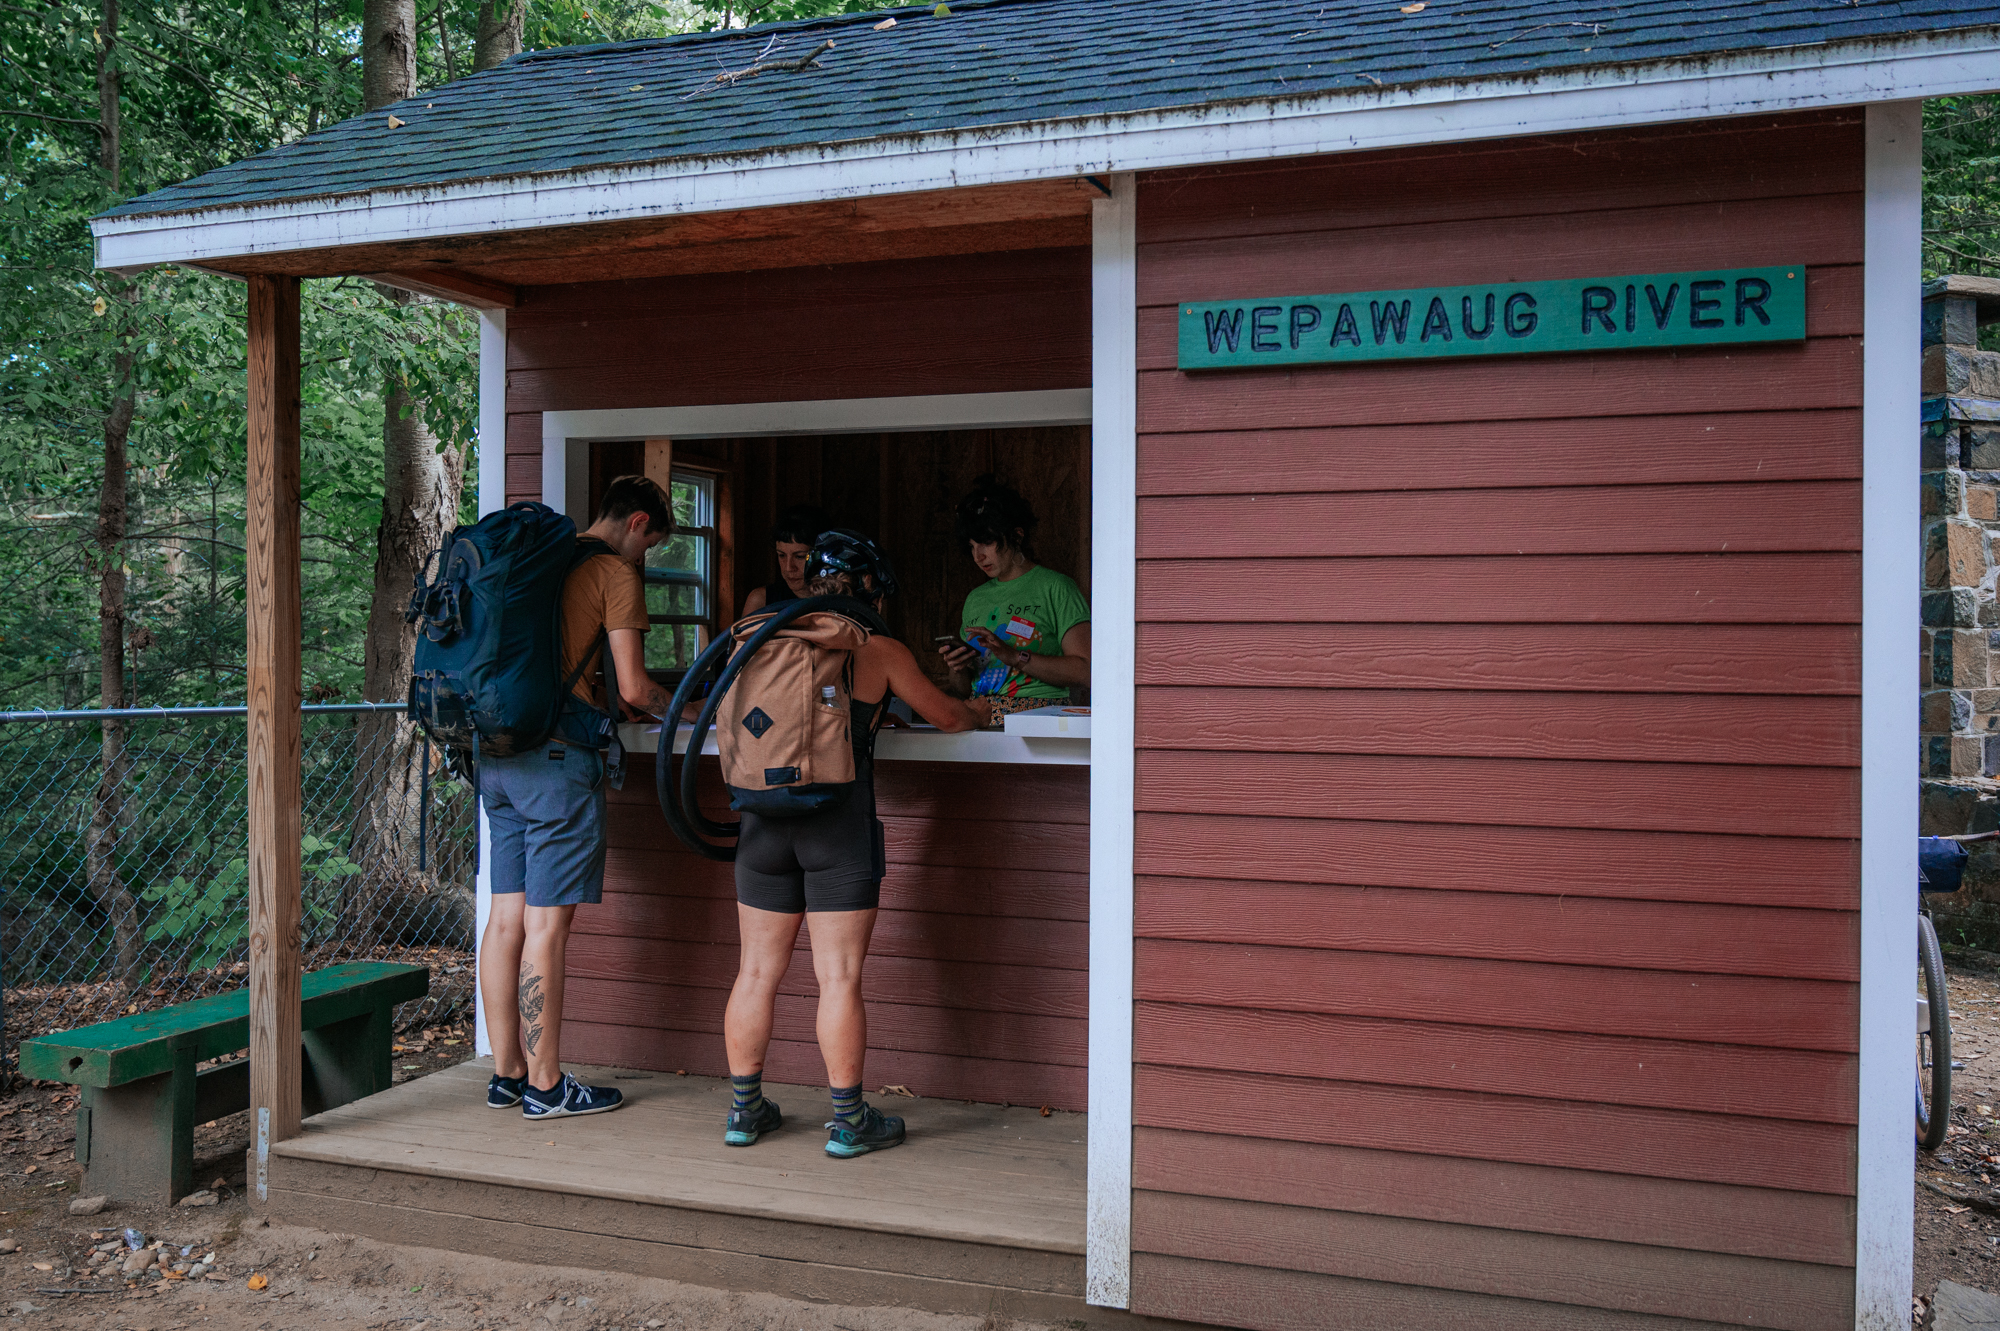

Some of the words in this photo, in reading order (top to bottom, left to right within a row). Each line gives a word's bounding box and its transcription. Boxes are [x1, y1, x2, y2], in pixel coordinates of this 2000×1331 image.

[1204, 292, 1538, 355] WEPAWAUG
[1581, 277, 1772, 335] RIVER
[1006, 603, 1041, 615] SOFT
